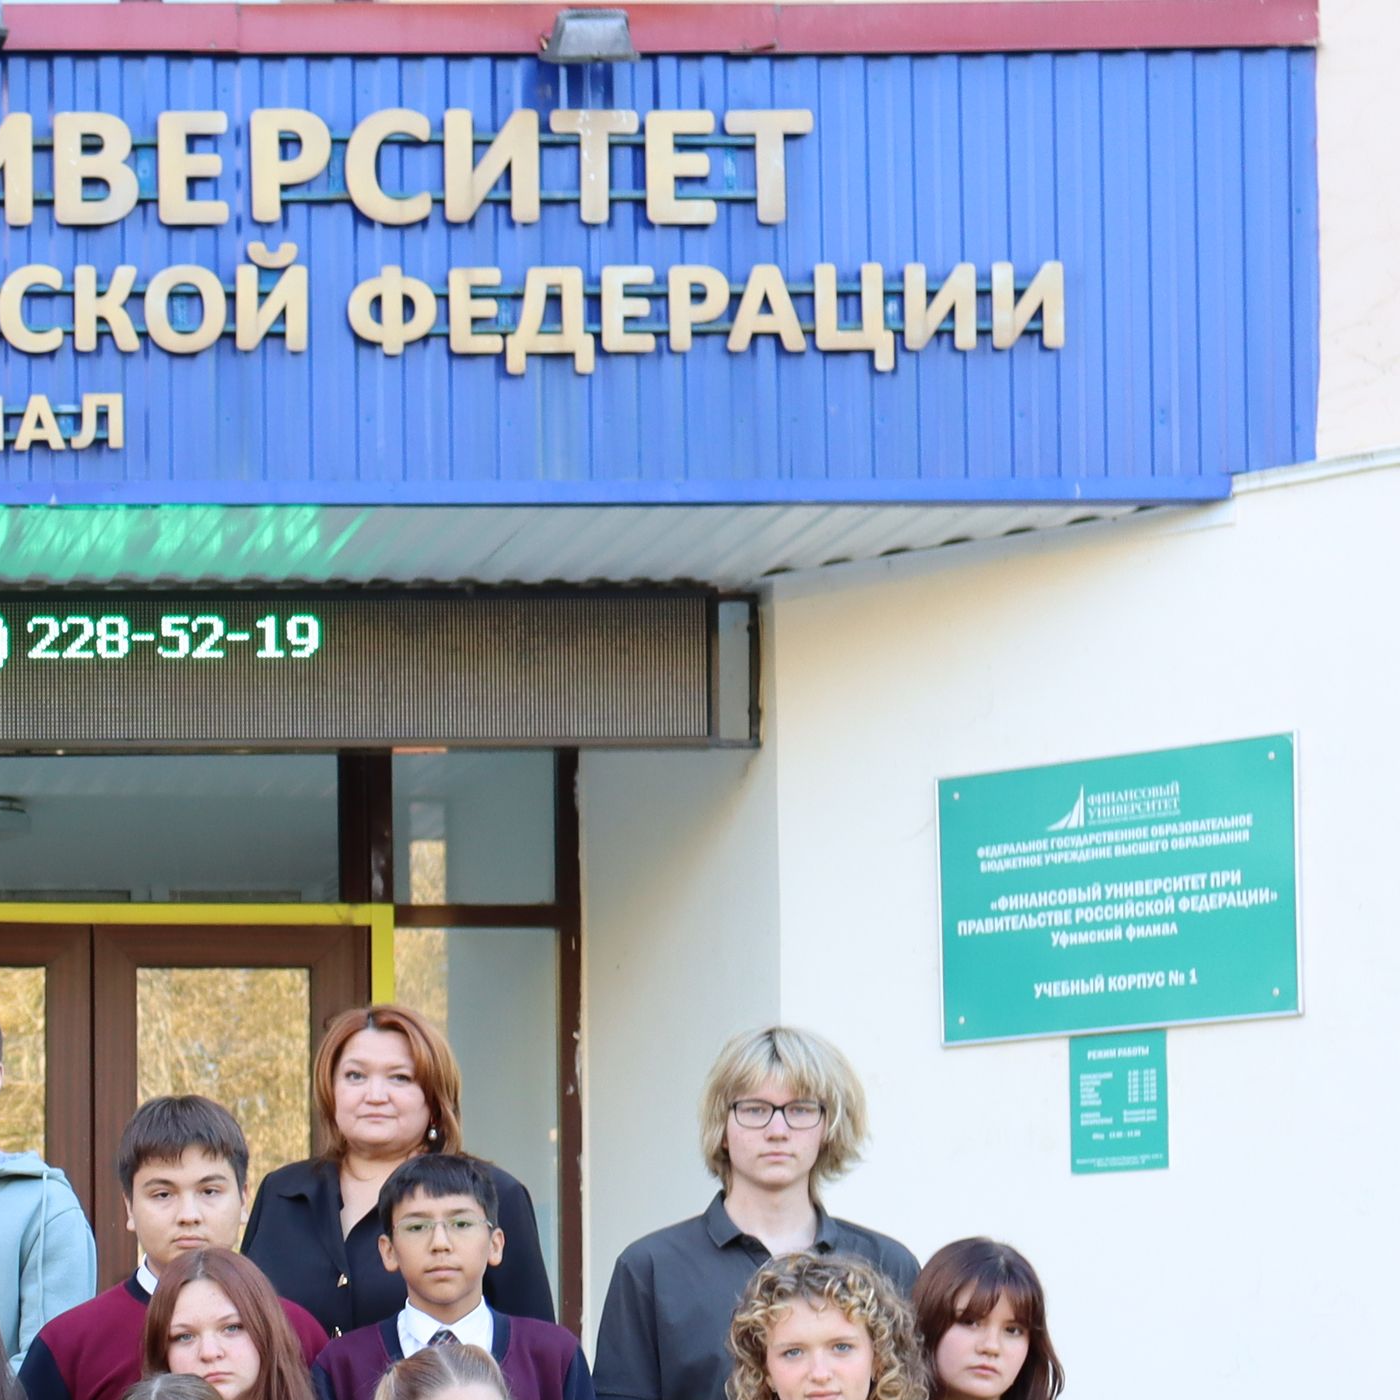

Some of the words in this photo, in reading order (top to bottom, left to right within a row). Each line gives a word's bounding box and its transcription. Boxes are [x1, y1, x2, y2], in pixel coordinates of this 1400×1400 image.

[347, 261, 1066, 375] ФЕДЕРАЦИИ
[25, 617, 321, 662] 228-52-19
[1087, 780, 1180, 807] ФИНАНСОВЫЙ
[1087, 796, 1180, 820] УНИВЕРСИТЕТ
[976, 837, 1049, 859] ФЕДЕРАЛЬНОЕ
[1050, 823, 1149, 851] ГОСУДАРСТВЕННОЕ
[1151, 813, 1253, 839] ОБРАЗОВАТЕЛЬНОЕ
[980, 853, 1043, 873] БЮДЖЕТНОЕ
[1045, 845, 1113, 866] УЧРЕЖДЕНИЕ
[1114, 837, 1169, 858] ВЫСШЕГО
[1171, 829, 1250, 851] ОБРАЗОВАНИЯ
[957, 908, 1073, 937] ПРАВИТЕЛЬСТВЕ
[1075, 895, 1175, 925] РОССИЙСКОЙ
[1178, 887, 1278, 913] ФЕДЕРАЦИИ»
[990, 882, 1102, 912] «ФИНАНСОВЫЙ
[1104, 873, 1207, 899] УНИВЕРСИТЕТ
[1210, 869, 1242, 889] ПРИ
[1051, 924, 1123, 948] Уфимский
[1125, 921, 1178, 943] филиал
[1034, 973, 1104, 999] УЧЕБНЫЙ
[1108, 970, 1165, 992] КОРПУС
[1189, 968, 1198, 985] 1
